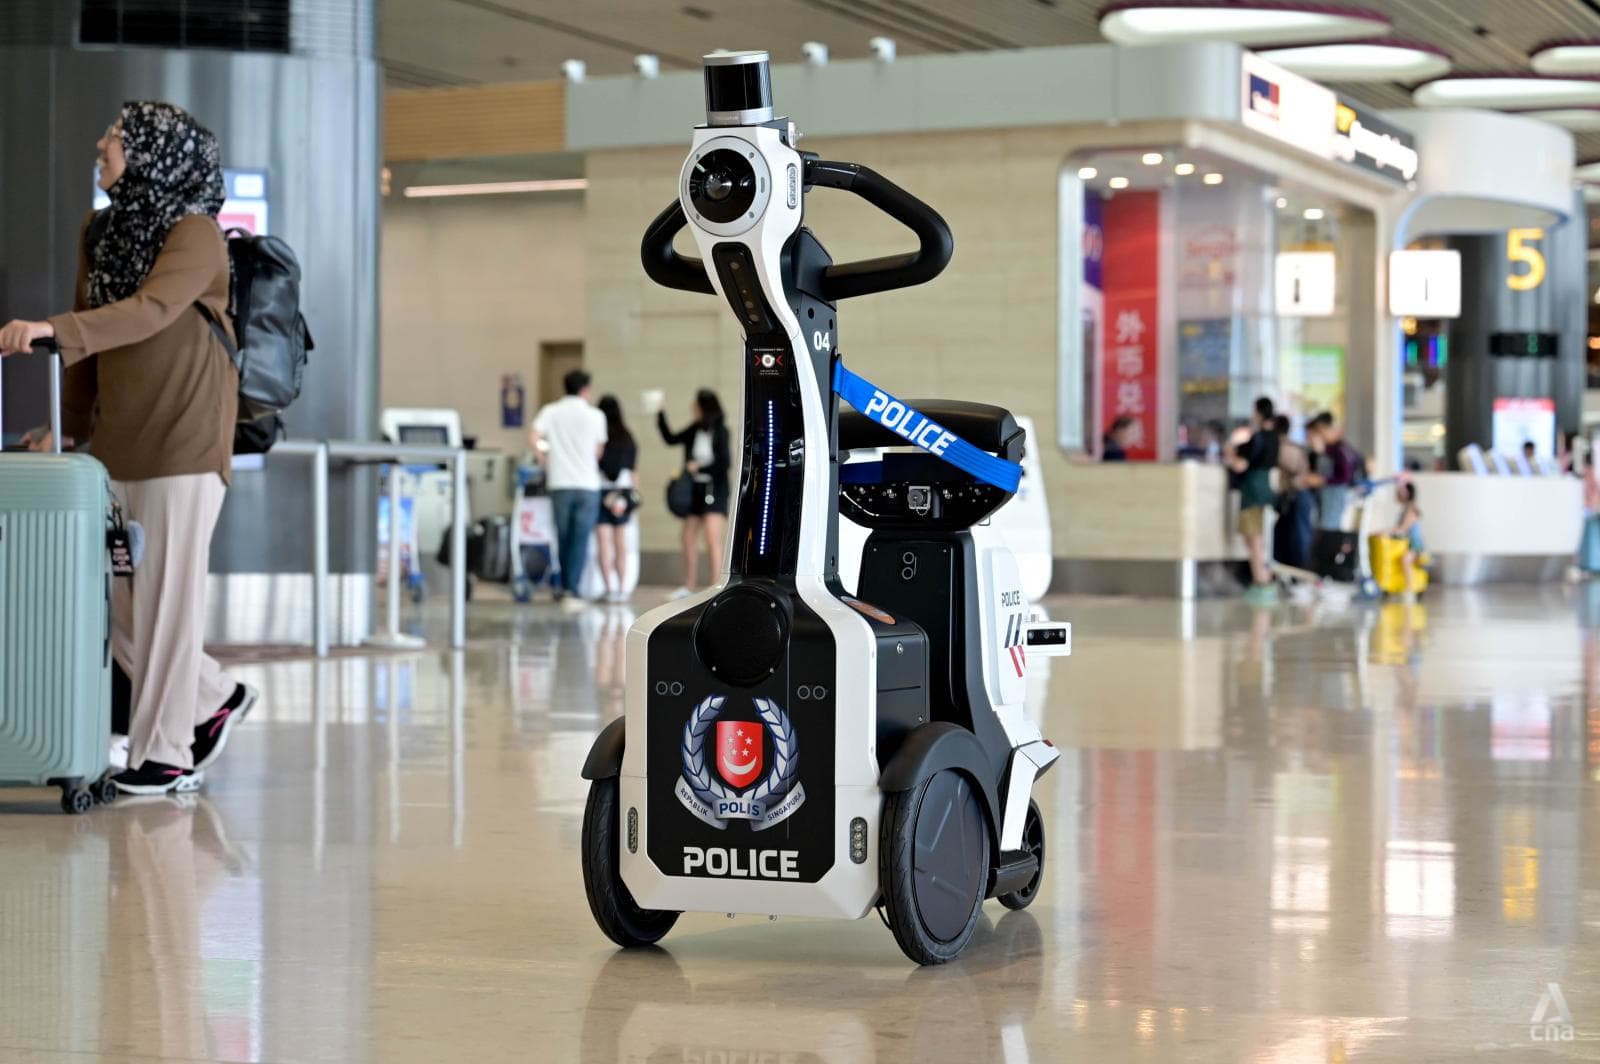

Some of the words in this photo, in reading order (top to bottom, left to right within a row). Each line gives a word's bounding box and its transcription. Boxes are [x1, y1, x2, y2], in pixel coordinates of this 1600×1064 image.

[1506, 228, 1546, 290] 5
[813, 331, 830, 351] 04
[864, 390, 957, 456] POLICE
[1001, 590, 1020, 607] POLICE
[680, 787, 708, 817] REPABLIK
[719, 801, 760, 816] POLIS
[767, 792, 803, 821] SINGAPURA
[683, 846, 800, 878] POLICE
